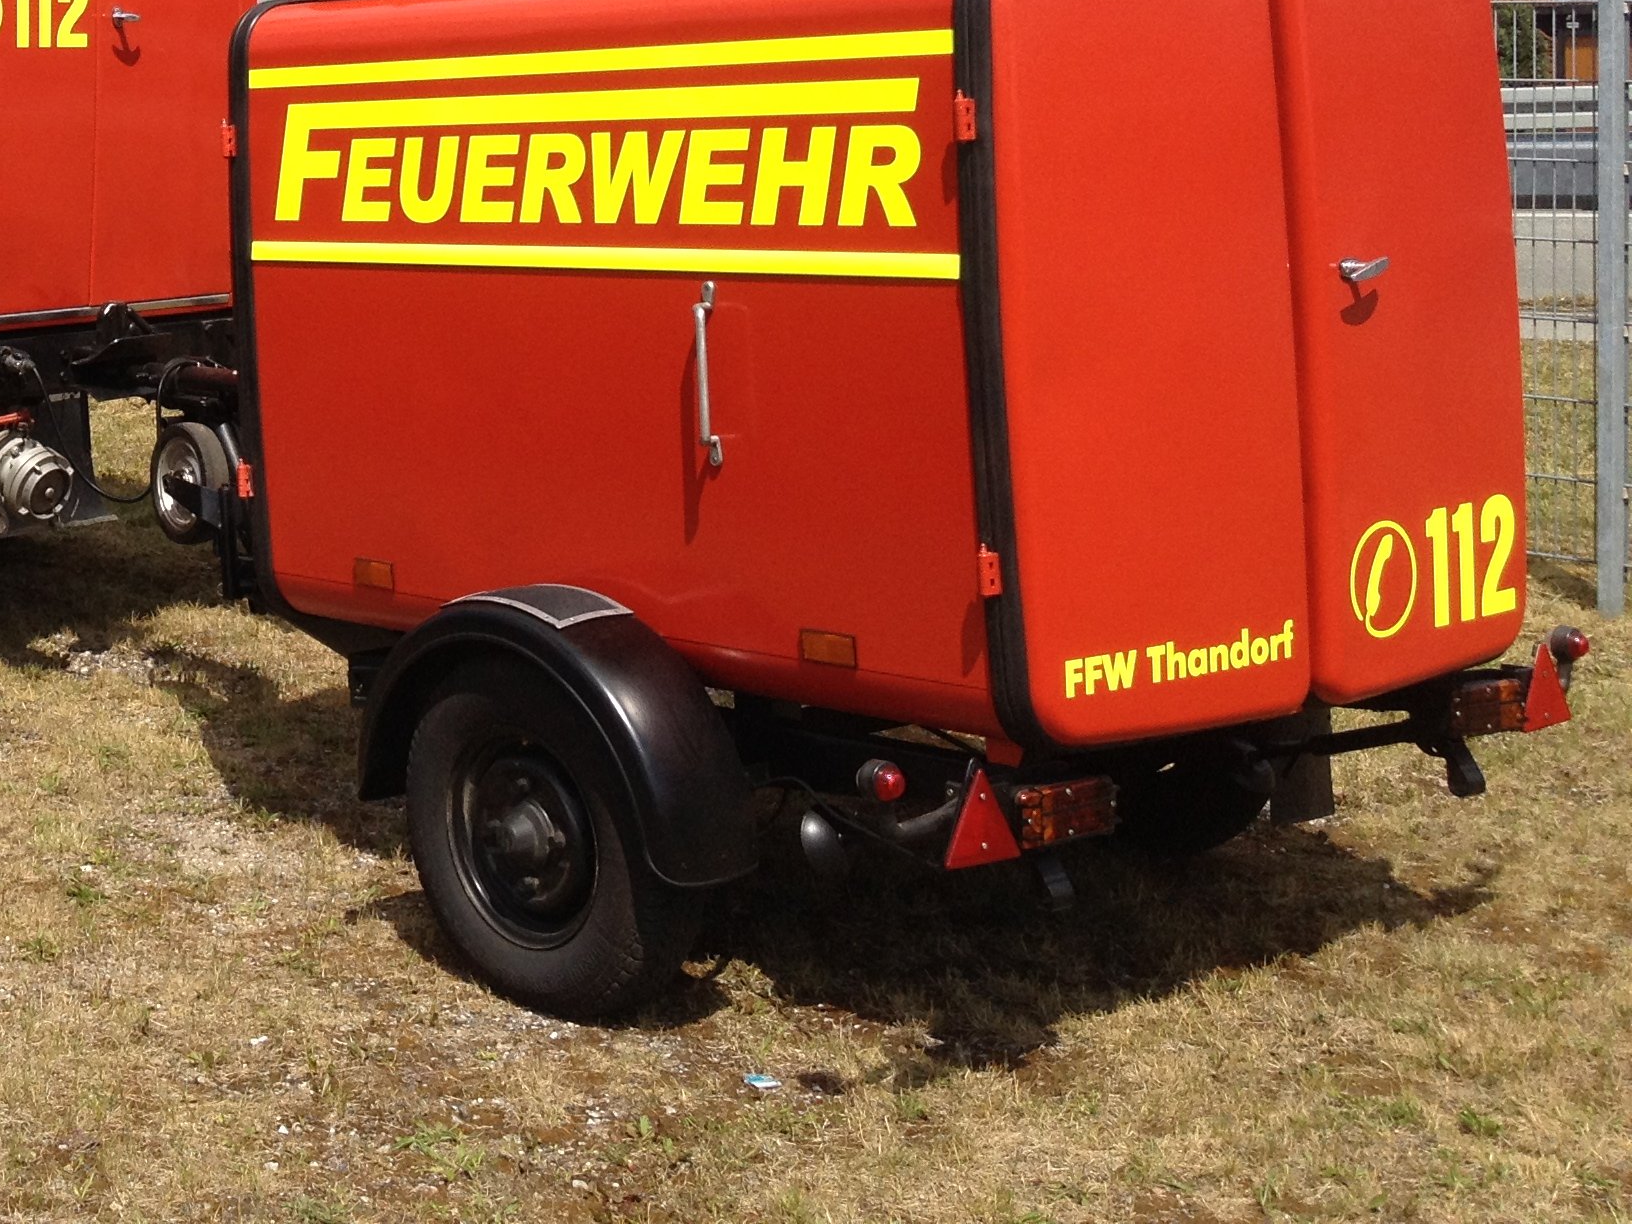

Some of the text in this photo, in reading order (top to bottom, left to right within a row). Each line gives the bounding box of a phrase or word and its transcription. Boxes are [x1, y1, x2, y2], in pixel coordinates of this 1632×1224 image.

[275, 78, 922, 227] FEUERWEHR
[1425, 493, 1517, 628] 112
[1065, 619, 1294, 699] FFW Thandorf
